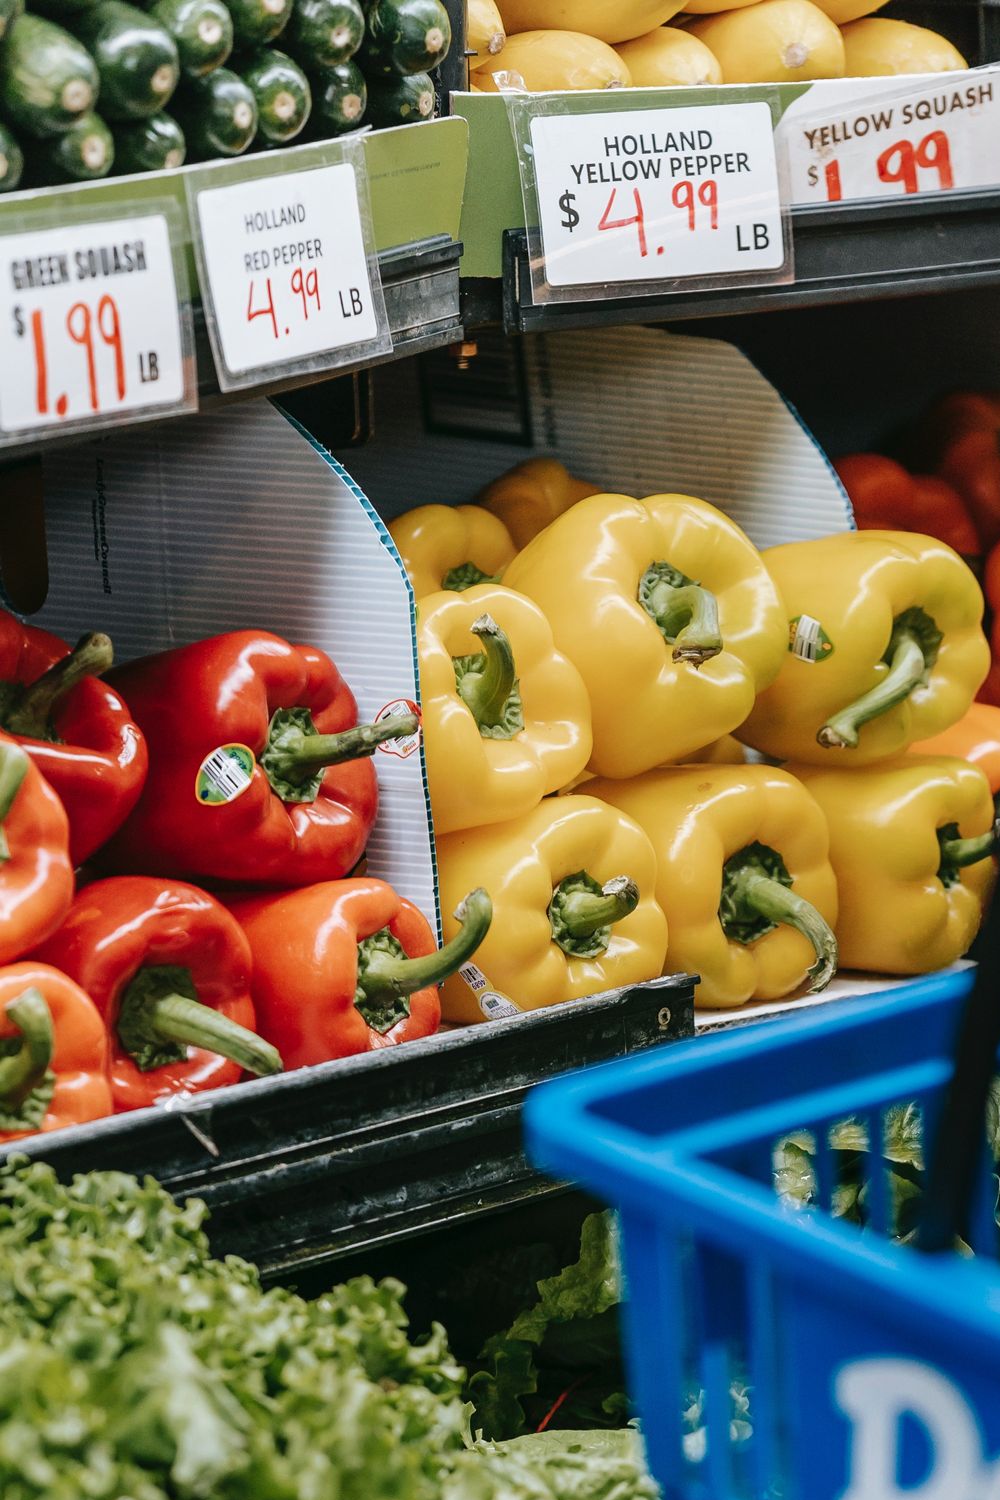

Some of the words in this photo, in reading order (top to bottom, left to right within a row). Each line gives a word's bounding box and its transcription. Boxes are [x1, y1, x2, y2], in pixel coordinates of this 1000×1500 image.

[803, 109, 893, 149] YELLOW
[903, 83, 992, 125] SQUASH
[604, 129, 712, 157] HOLLAND
[570, 158, 661, 185] YELLOW
[670, 152, 751, 177] PEPPER
[807, 164, 819, 187] $
[244, 204, 306, 234] HOLLAND
[558, 189, 580, 233] $
[598, 179, 718, 257] 4.99
[736, 223, 770, 252] LB
[11, 254, 70, 290] GREEN
[75, 240, 147, 280] SQUASH
[244, 250, 271, 273] RED
[273, 238, 323, 267] PEPPER
[247, 266, 321, 338] 4.99
[338, 288, 363, 318] LB
[14, 306, 25, 338] $
[31, 293, 126, 416] 1.99
[138, 351, 159, 383] LB
